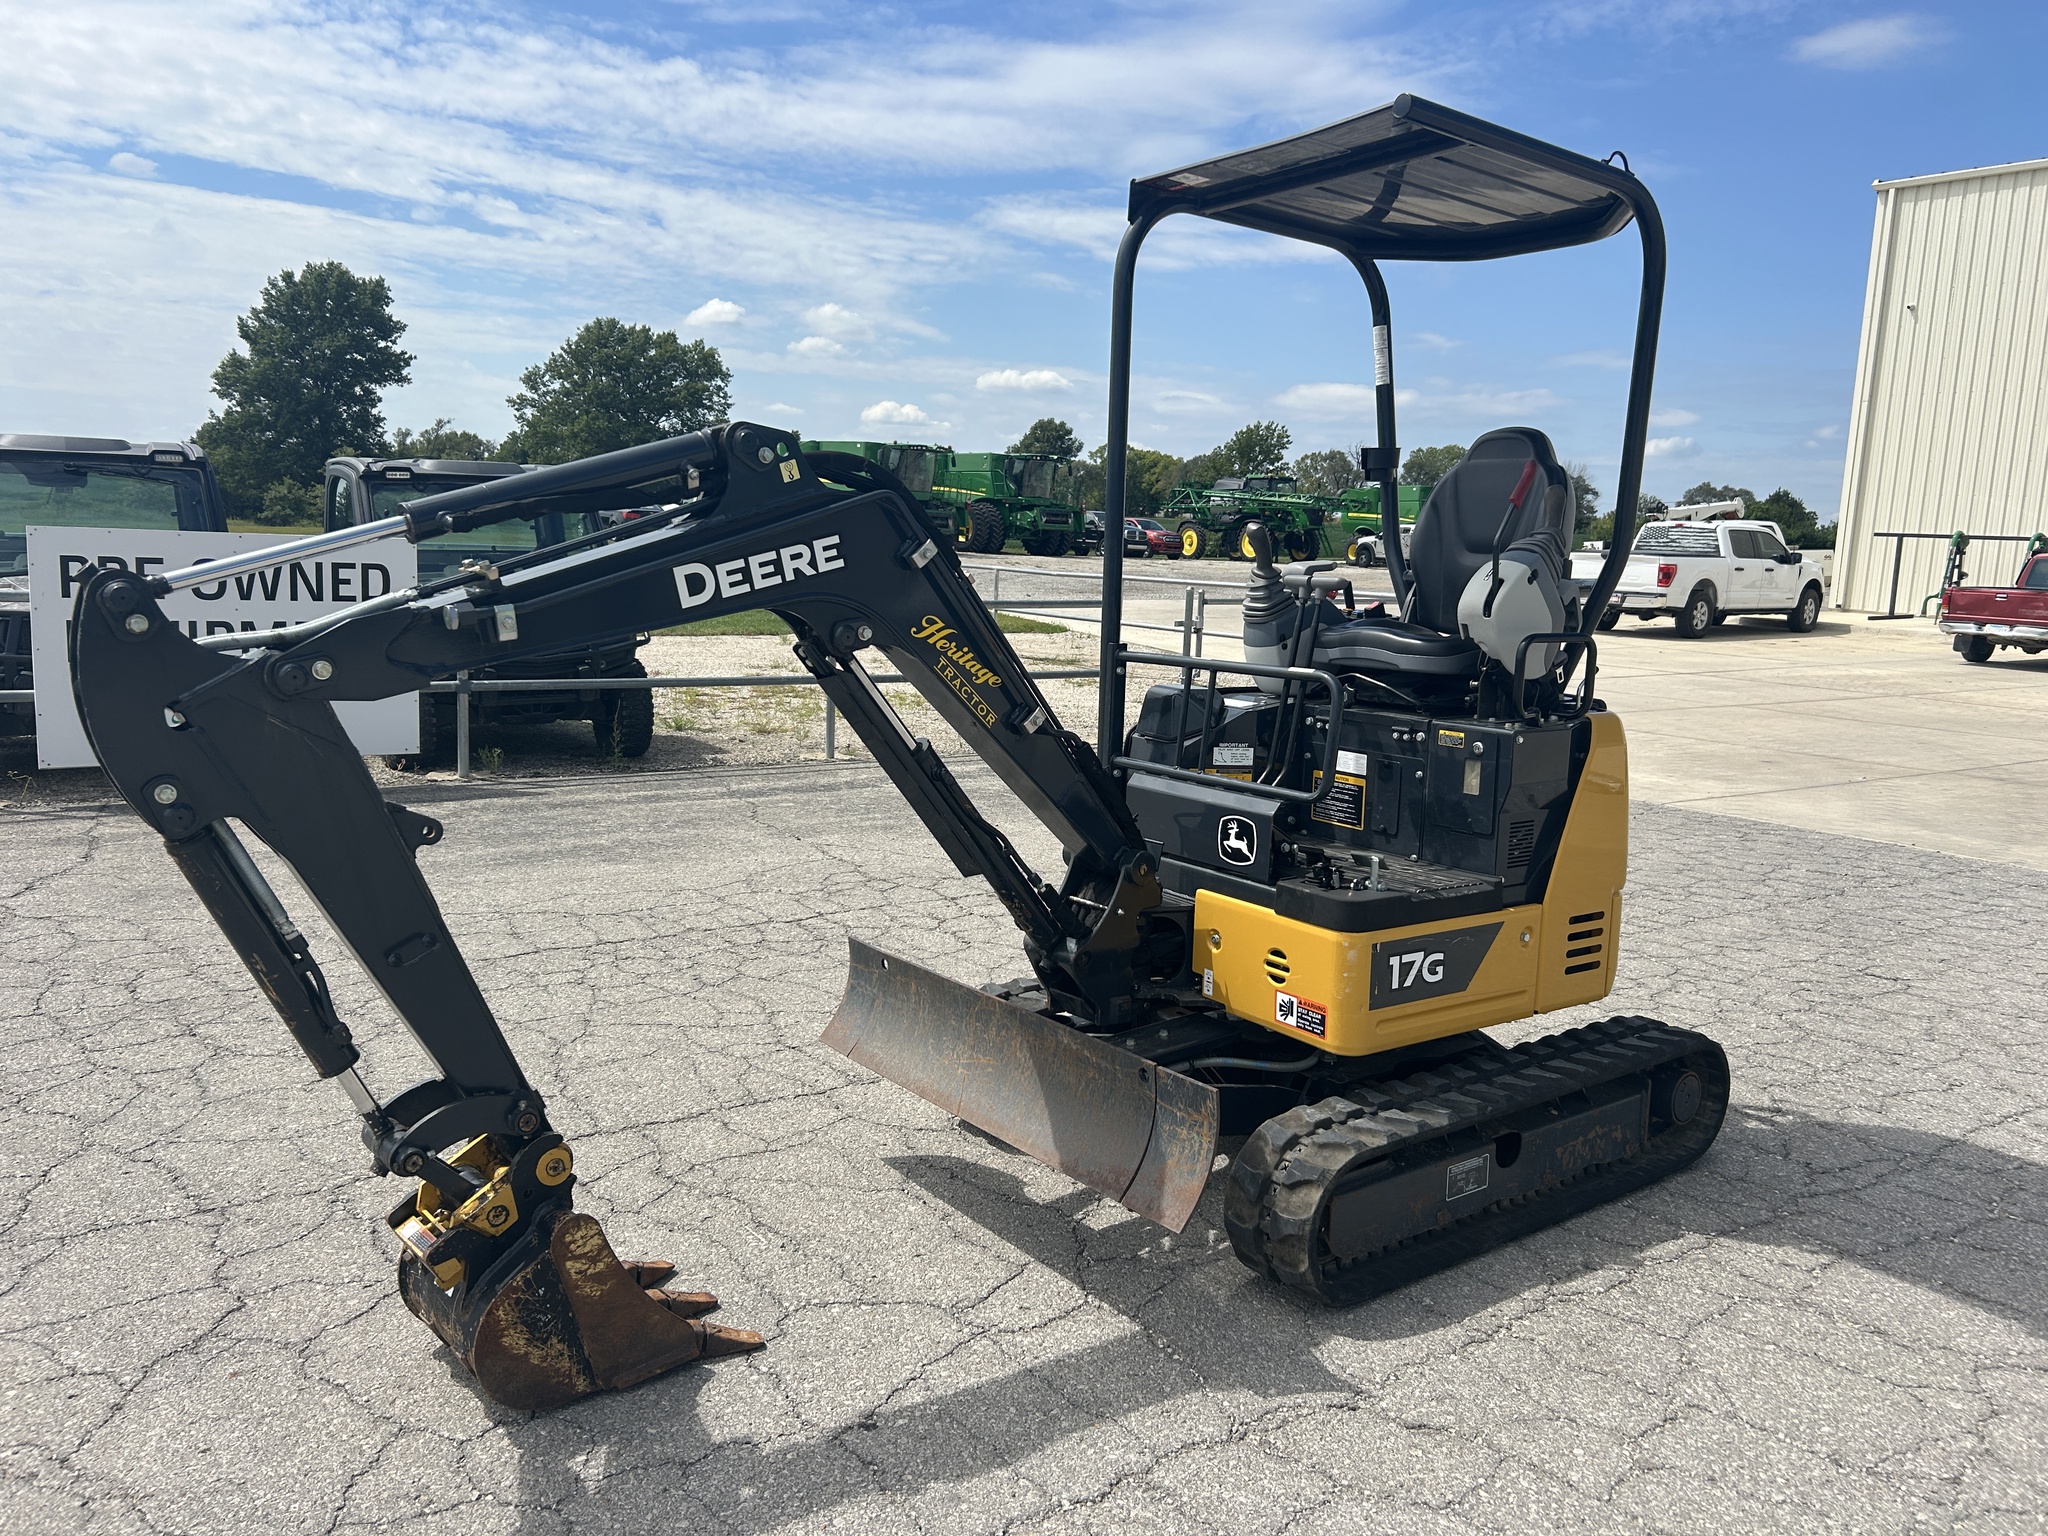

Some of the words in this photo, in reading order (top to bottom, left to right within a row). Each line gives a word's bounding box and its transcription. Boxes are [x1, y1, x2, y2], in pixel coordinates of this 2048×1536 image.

[673, 535, 845, 609] DEERE
[911, 615, 1002, 688] Heritage
[937, 659, 996, 726] TRACTOR
[1389, 951, 1444, 989] 17G
